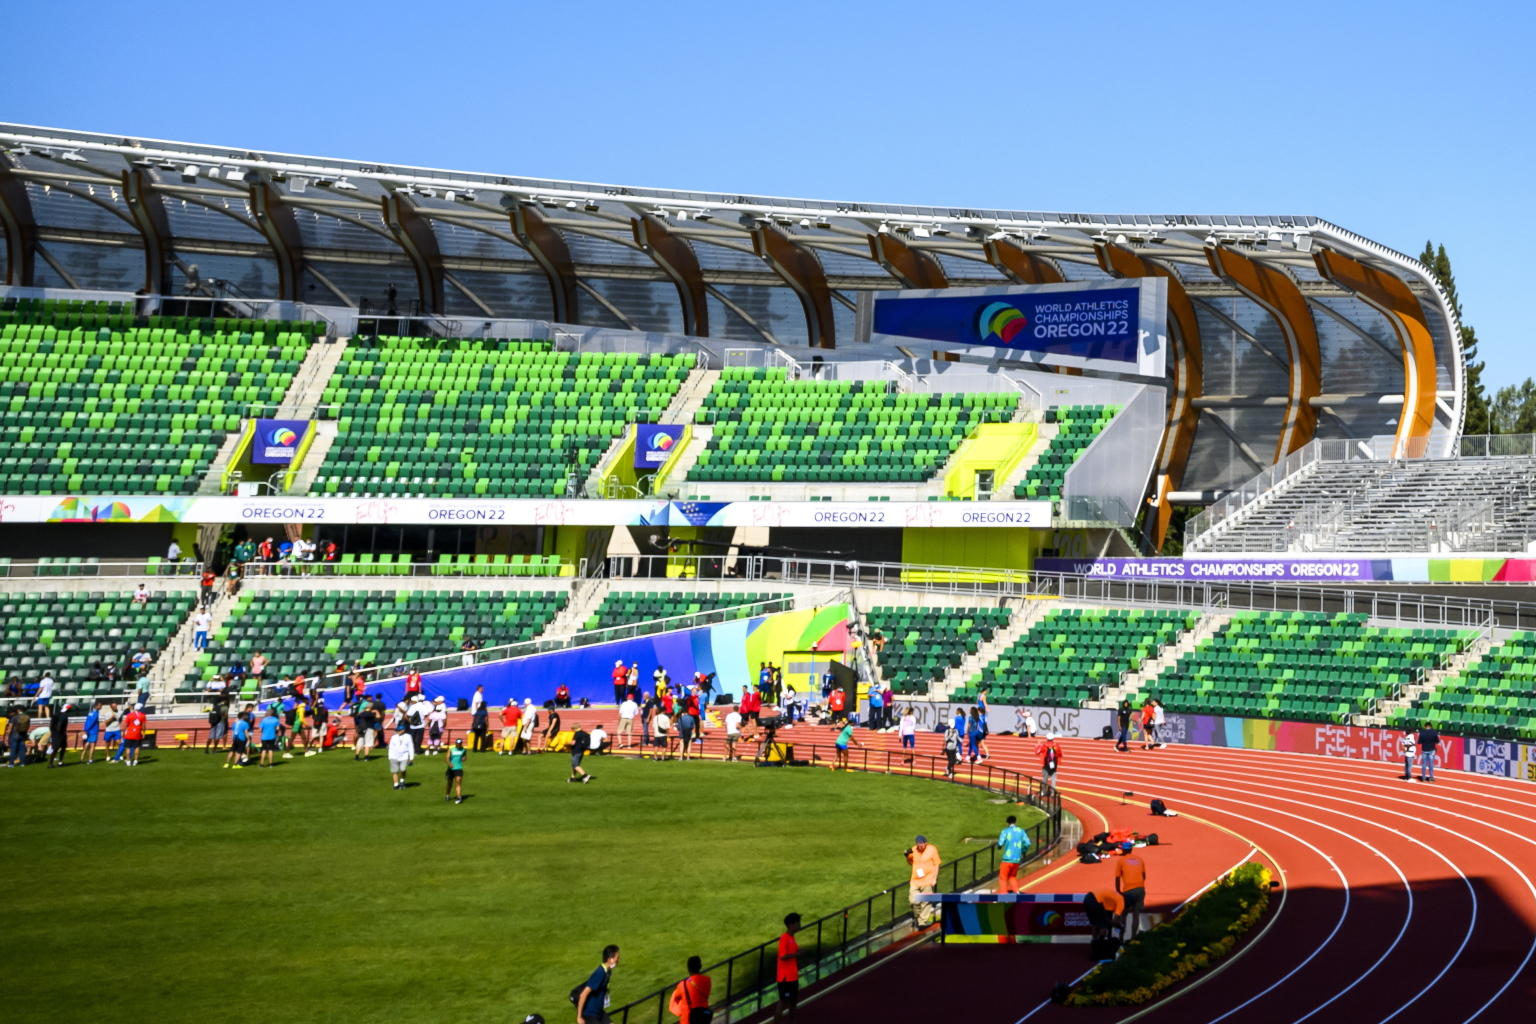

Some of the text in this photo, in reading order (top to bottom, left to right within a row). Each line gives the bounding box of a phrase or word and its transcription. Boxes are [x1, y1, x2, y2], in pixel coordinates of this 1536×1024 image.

[1035, 300, 1129, 313] WORLD ATHLETICS
[1034, 310, 1129, 324] CHAMPIONSHIPS
[1074, 563, 1116, 576] WORLD
[1122, 563, 1185, 576] ATHLETICS
[1190, 563, 1284, 576] CHAMPIONSHIPS
